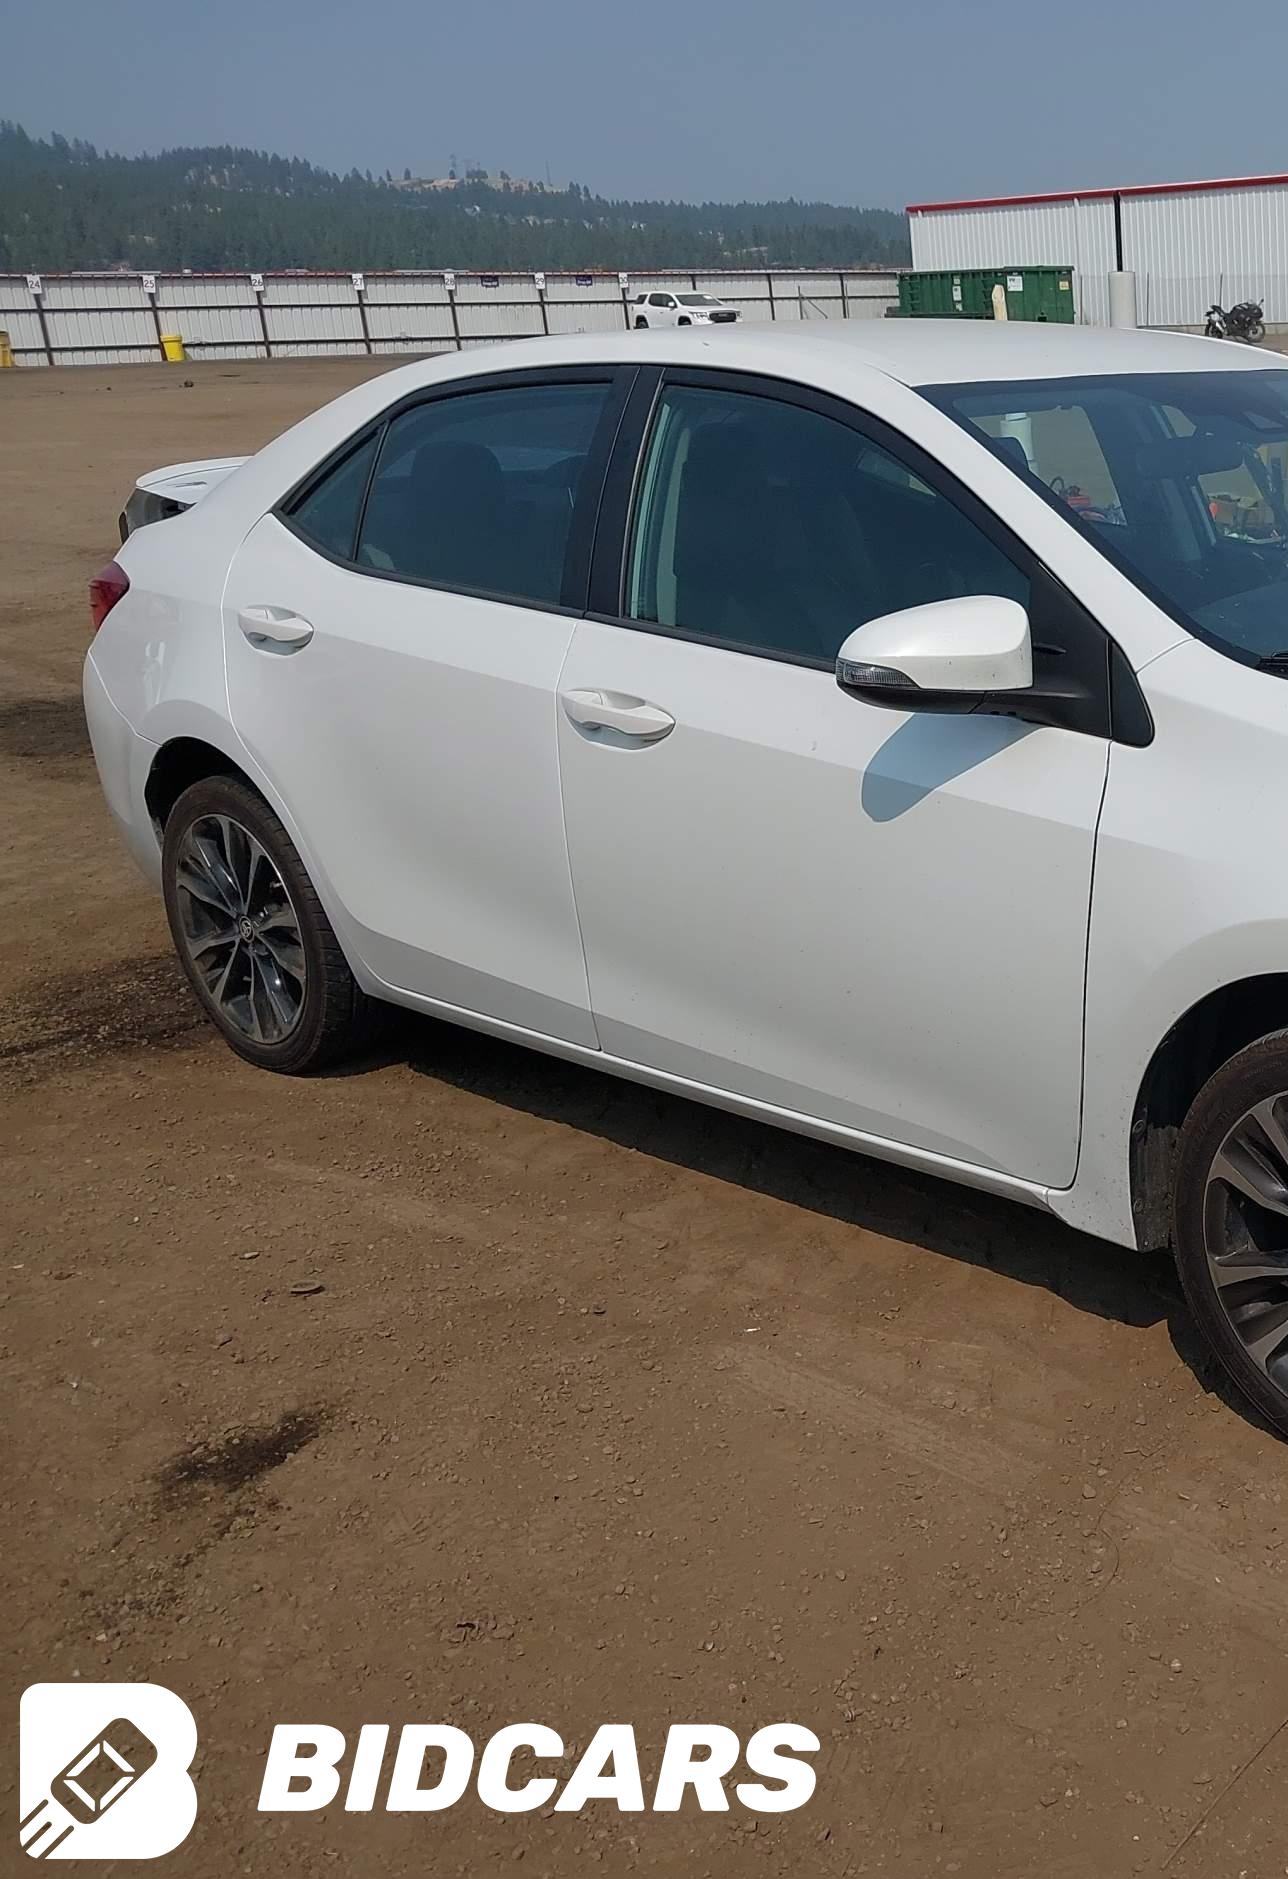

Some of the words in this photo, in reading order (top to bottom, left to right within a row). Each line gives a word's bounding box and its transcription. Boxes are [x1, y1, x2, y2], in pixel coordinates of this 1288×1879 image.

[28, 280, 41, 289] 24
[143, 280, 155, 289] 25
[535, 277, 545, 286] 29
